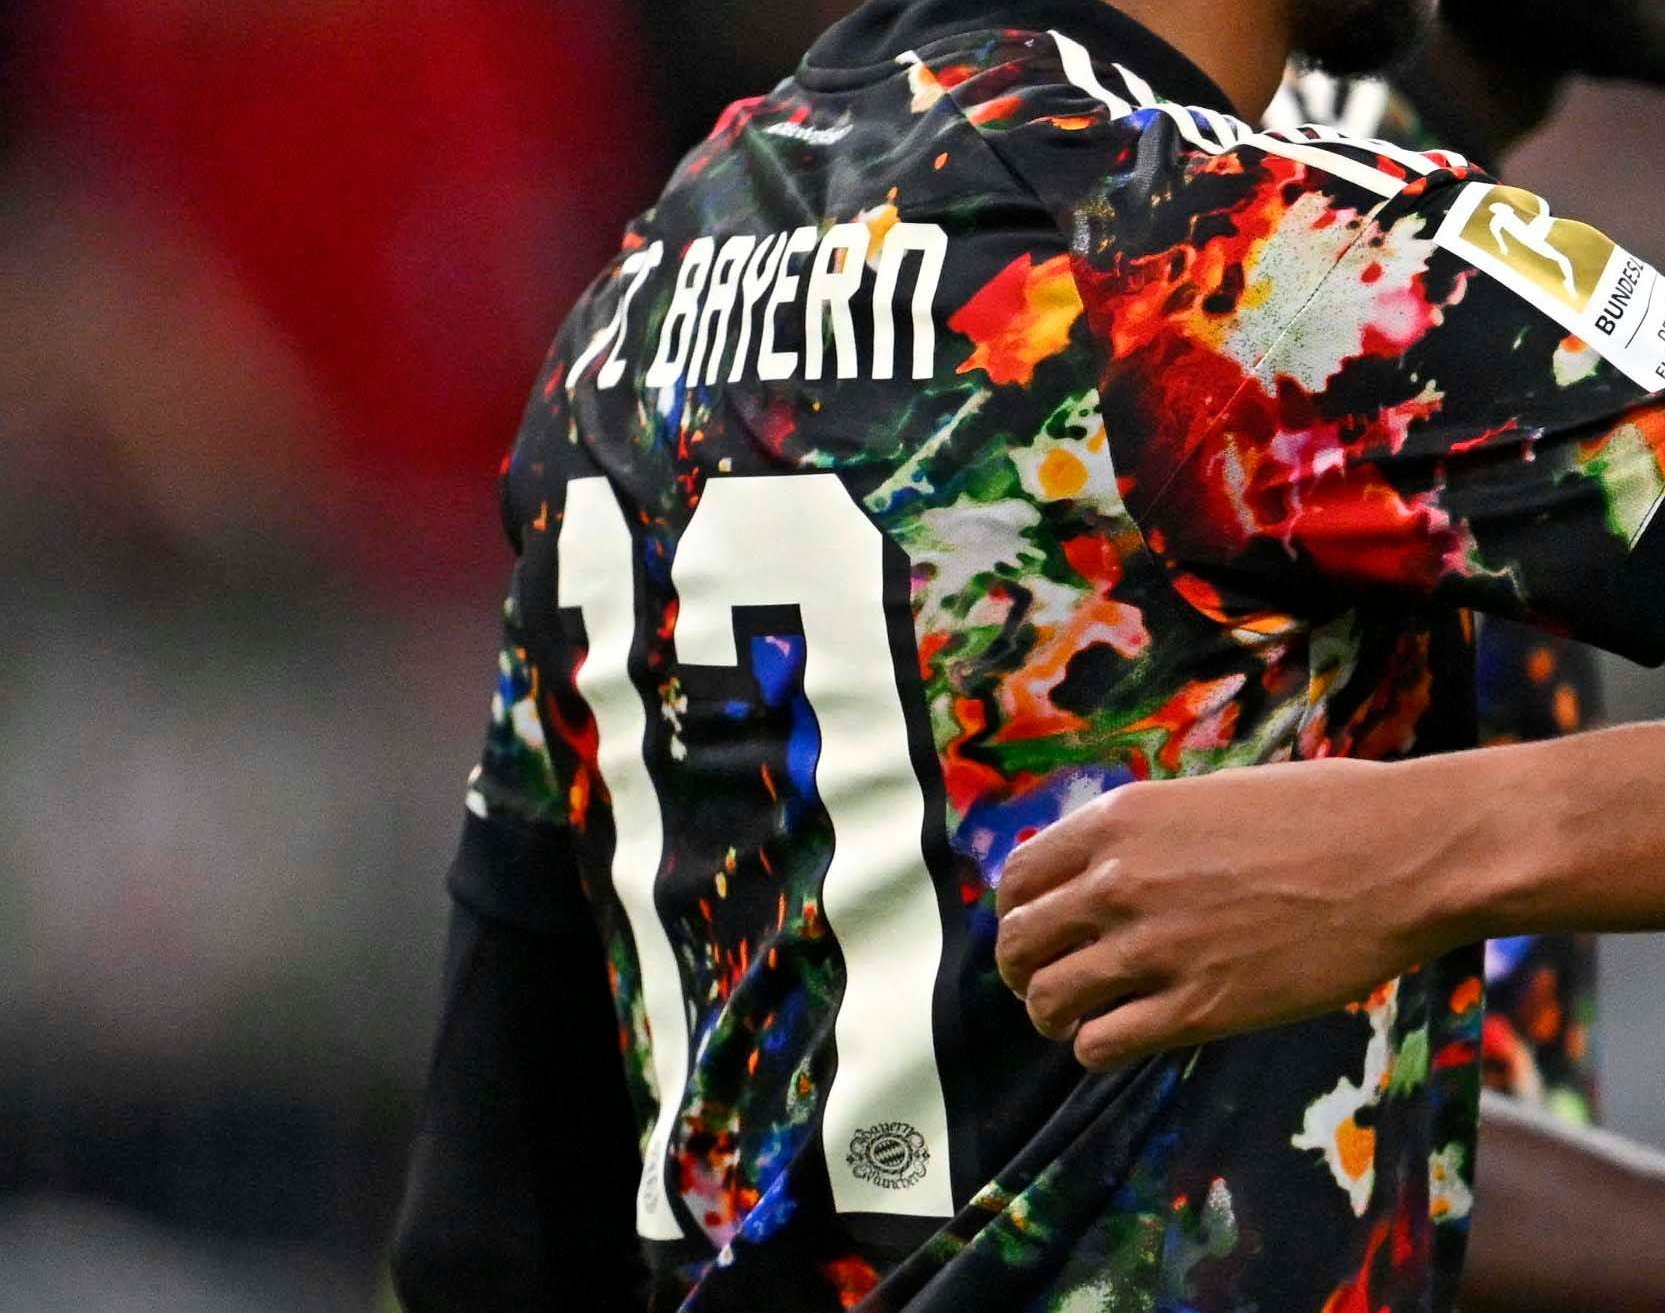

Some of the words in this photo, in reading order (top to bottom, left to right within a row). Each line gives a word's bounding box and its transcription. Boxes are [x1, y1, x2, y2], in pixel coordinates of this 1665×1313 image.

[645, 222, 948, 389] BAYERN
[1594, 255, 1644, 337] BUNDESL
[558, 473, 954, 1241] 17
